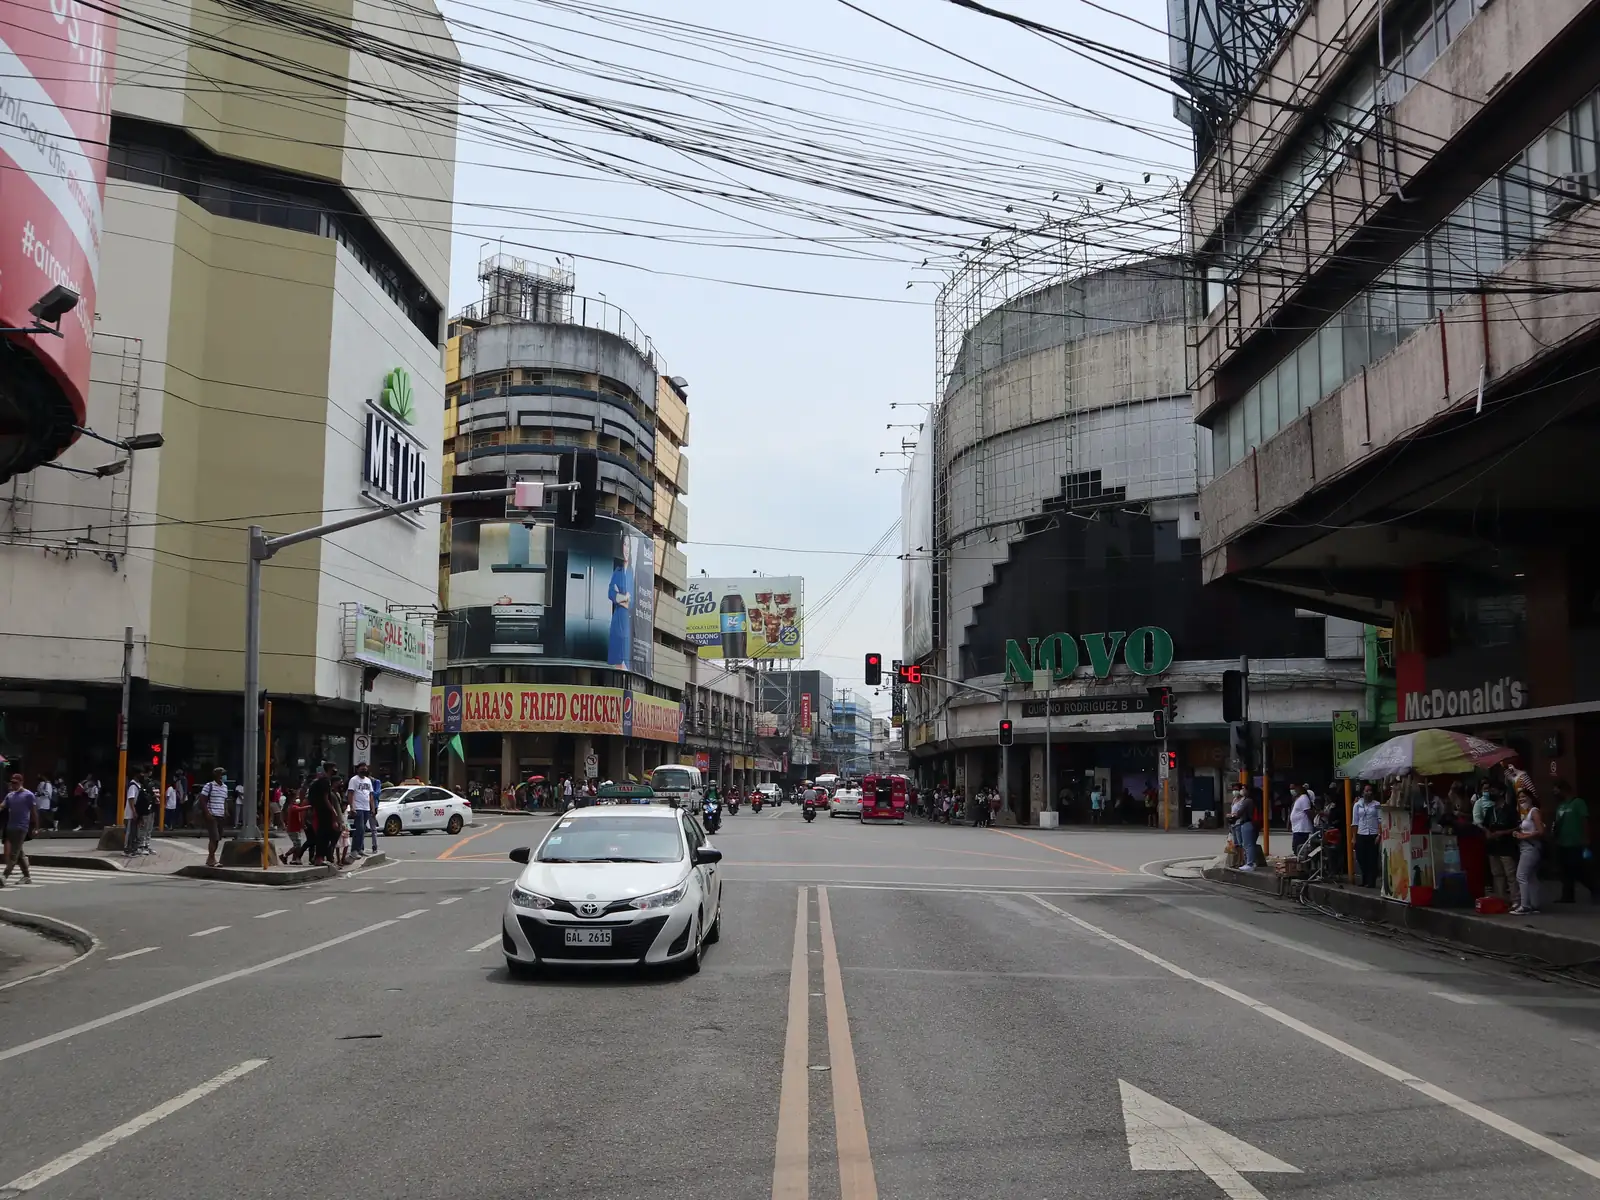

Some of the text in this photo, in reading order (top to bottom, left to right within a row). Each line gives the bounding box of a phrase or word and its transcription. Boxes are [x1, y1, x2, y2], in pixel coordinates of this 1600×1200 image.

[365, 413, 427, 516] METRO
[689, 583, 699, 591] RC
[686, 602, 716, 617] TRO
[384, 621, 402, 647] SALE
[696, 632, 719, 640] BUONG
[784, 631, 797, 642] 29
[1004, 626, 1174, 683] NOVO
[901, 665, 921, 683] 46
[1404, 676, 1523, 720] McDonald's
[464, 691, 513, 721] KARA'S
[519, 691, 566, 721] FRIED
[570, 692, 622, 724] CHICKEN
[1028, 703, 1061, 715] QUIRNO
[1064, 700, 1119, 713] RODRIGUEZ
[448, 715, 461, 723] pepsi
[1338, 741, 1355, 750] BIKE
[1337, 751, 1357, 760] LANE
[565, 932, 611, 943] GAL 2615
